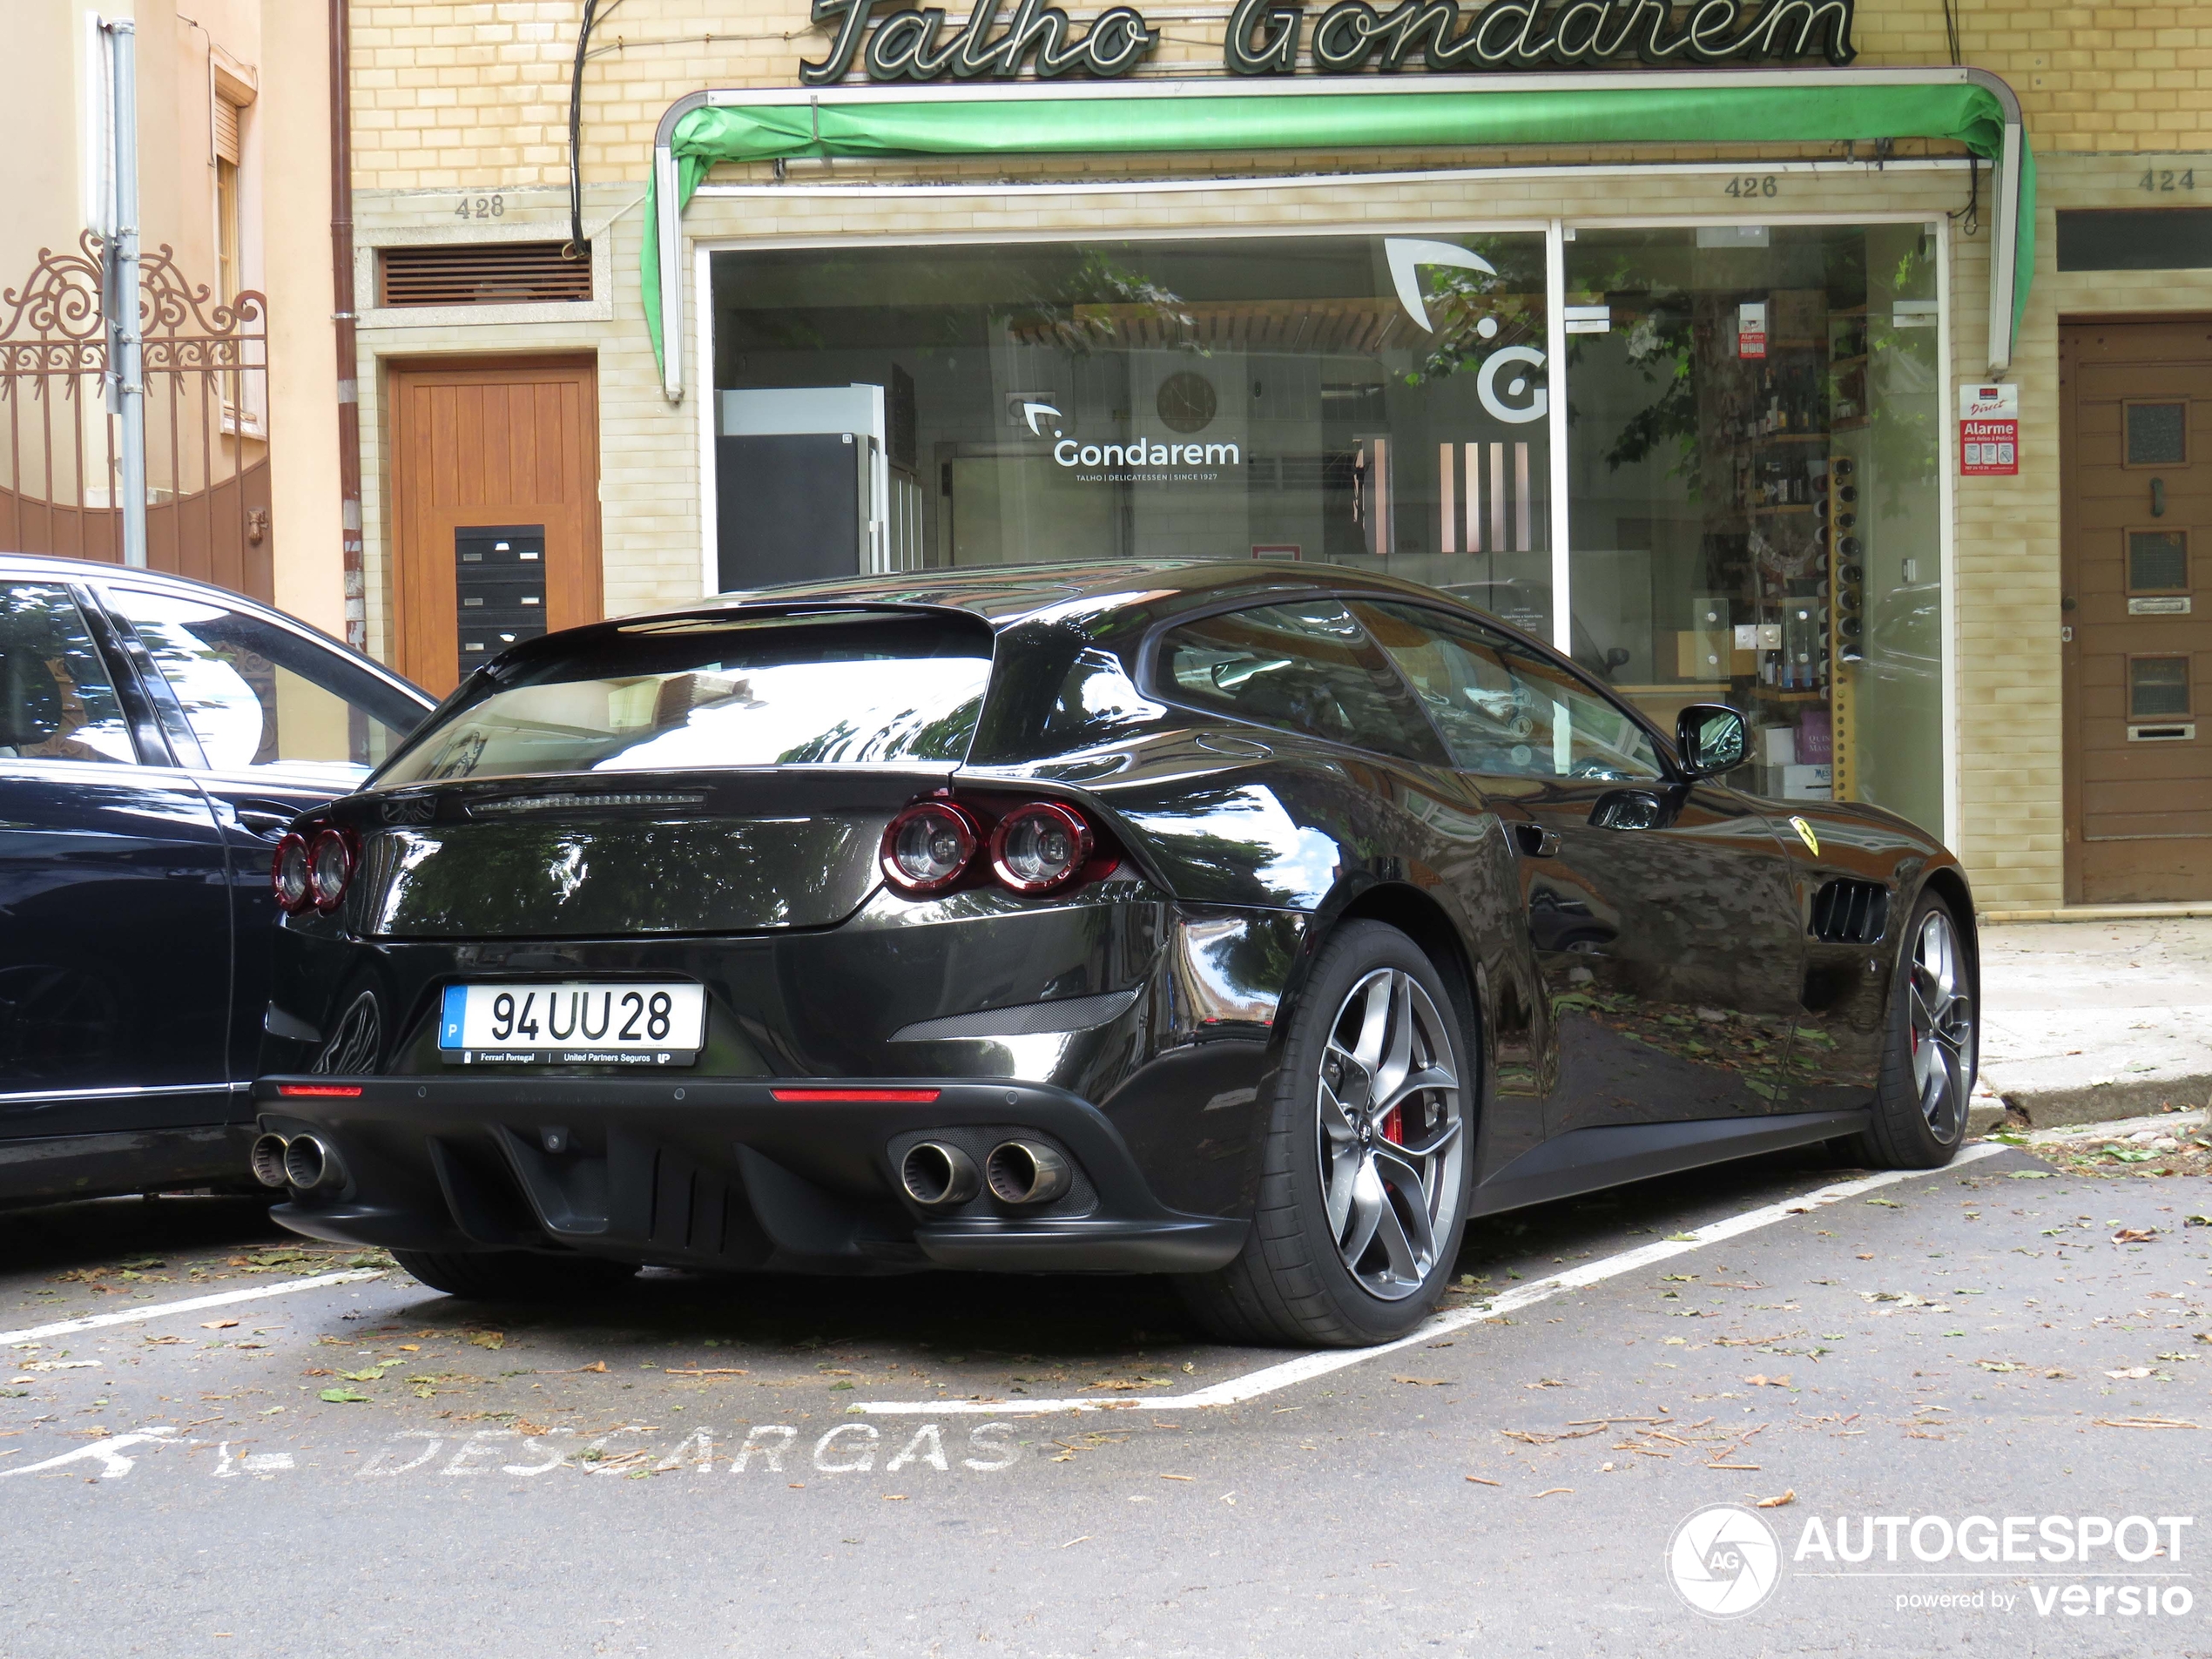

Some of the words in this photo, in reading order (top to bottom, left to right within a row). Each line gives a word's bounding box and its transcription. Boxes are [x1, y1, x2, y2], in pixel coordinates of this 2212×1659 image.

[799, 0, 1160, 85] Talho
[1220, 0, 1858, 75] Gondarem
[1723, 175, 1778, 199] 426
[2139, 167, 2195, 191] 424
[454, 193, 505, 219] 428
[1965, 422, 2014, 435] Alarme
[1053, 437, 1239, 467] Gondarem
[448, 1023, 458, 1038] P
[480, 1052, 505, 1062] Ferrari
[506, 1052, 535, 1062] Portugal
[563, 1052, 586, 1062] United
[588, 1052, 618, 1062] Partners
[620, 1052, 651, 1063] Seguros
[352, 1422, 1022, 1477] DESCARGAS
